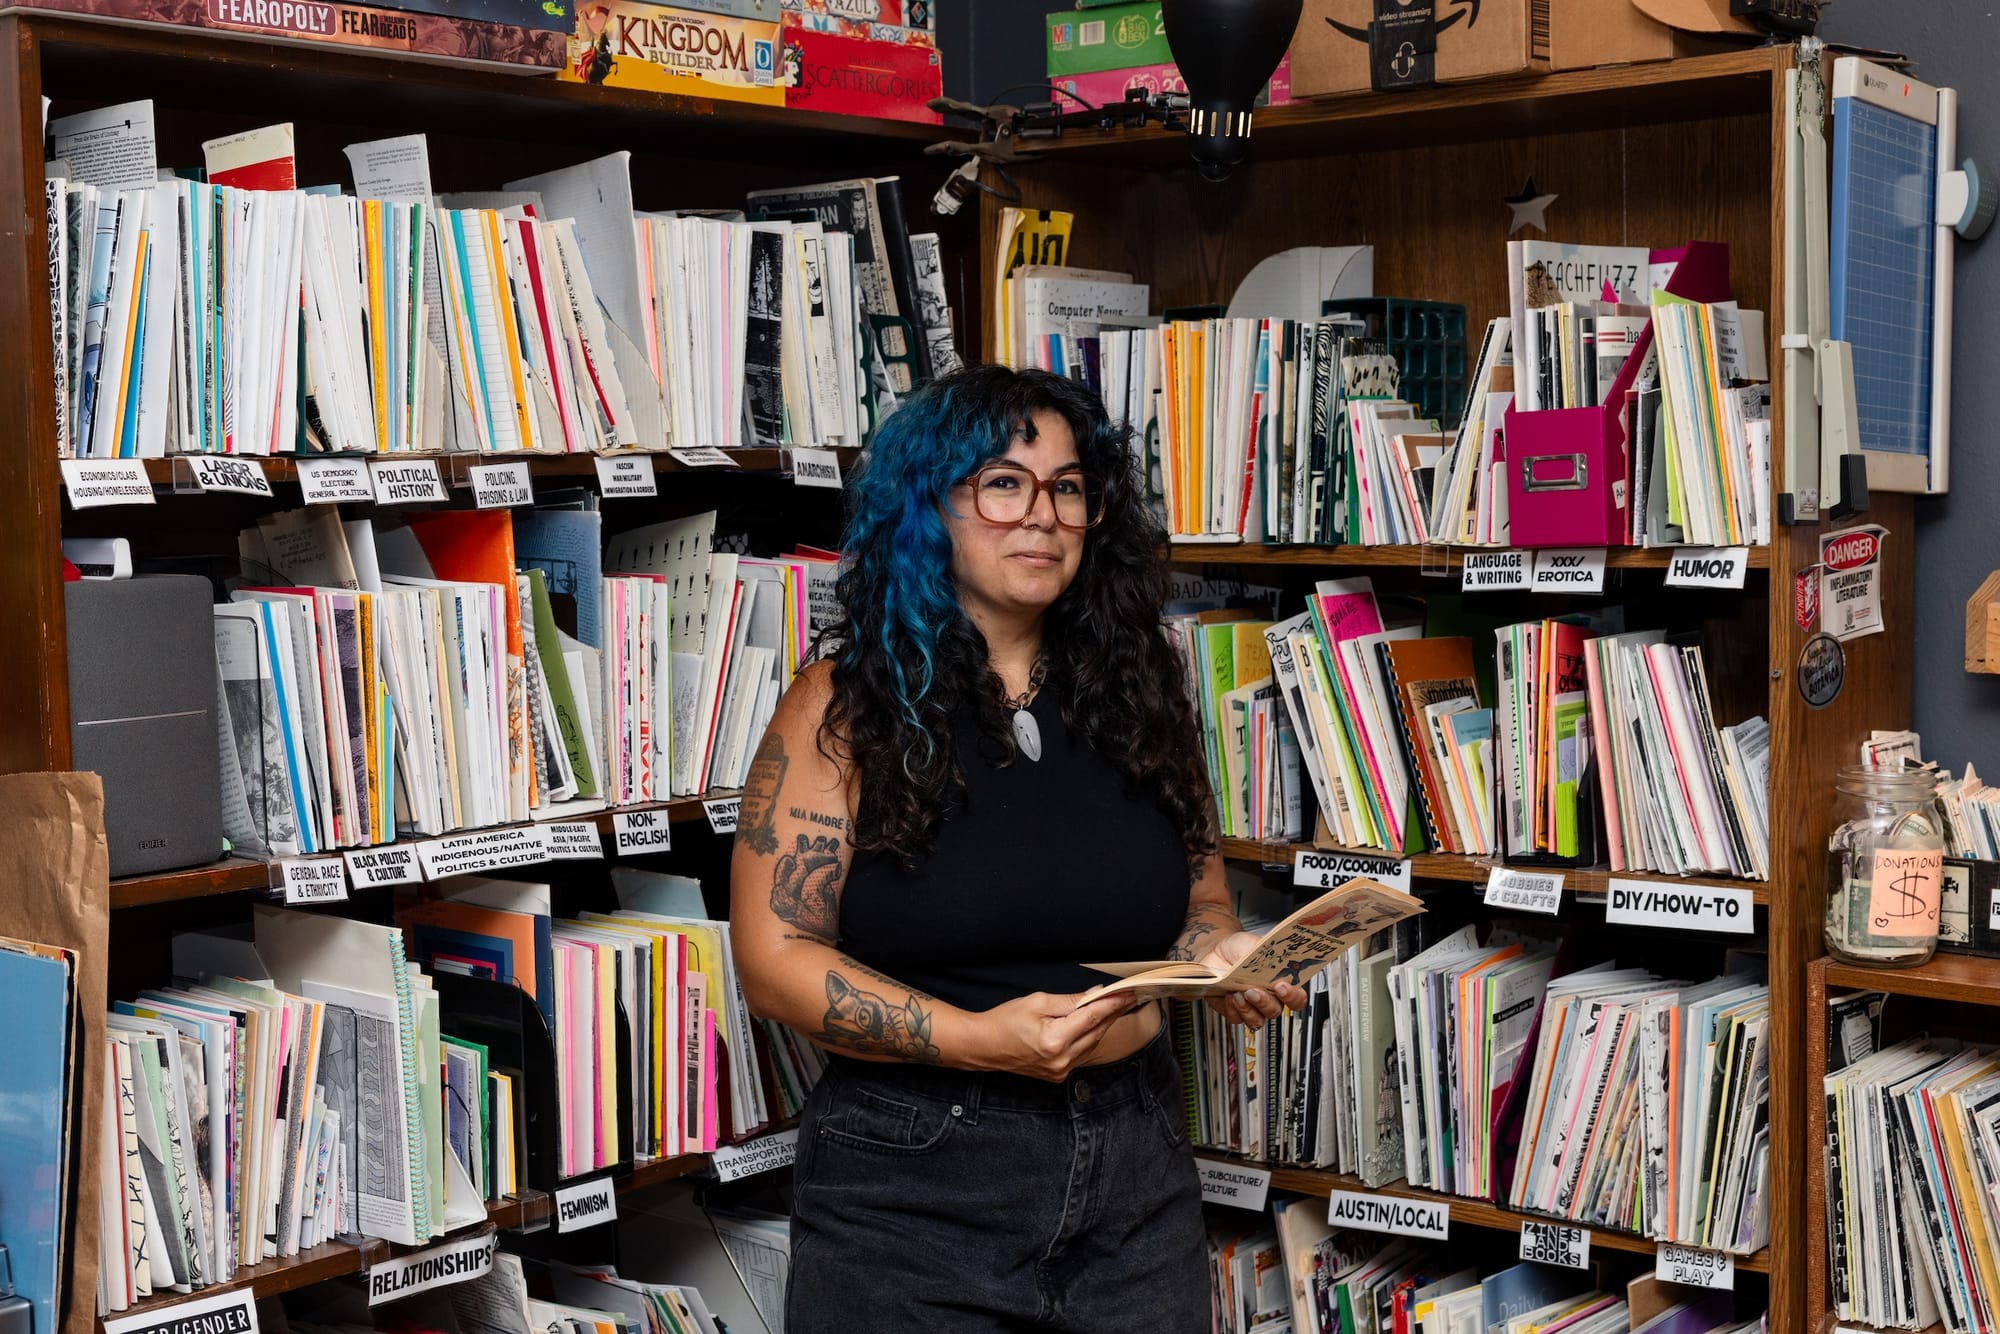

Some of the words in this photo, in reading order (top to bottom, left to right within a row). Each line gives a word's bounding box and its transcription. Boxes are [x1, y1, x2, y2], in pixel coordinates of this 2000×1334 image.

[218, 0, 329, 32] FEAROPOLY
[1379, 12, 1398, 22] video
[1399, 8, 1431, 20] streaming
[341, 10, 379, 37] FEAR
[408, 19, 417, 41] 6
[380, 24, 406, 40] DEAD
[1052, 23, 1073, 44] MB
[1128, 22, 1145, 33] BIG
[616, 13, 749, 72] KINGDOM
[1126, 31, 1146, 42] BEN
[649, 51, 717, 71] BUILDER
[807, 63, 936, 99] SCATTERGORIES
[1048, 302, 1093, 320] Computer
[202, 459, 250, 477] LABOR
[616, 462, 634, 470] FASCISM
[796, 462, 837, 480] ANARCHISM
[80, 471, 138, 482] ECONOMICS/CLASS
[200, 472, 214, 486] &
[214, 472, 268, 492] UNIONS
[321, 479, 355, 488] ELECTIONS
[377, 468, 437, 484] POLITICAL
[73, 485, 152, 498] HOUSING/HOMELESSNESS
[308, 490, 338, 498] GENERAL
[339, 489, 371, 497] POLITICAL
[388, 484, 435, 499] HISTORY
[479, 490, 507, 505] PRISONS
[508, 490, 514, 501] &
[514, 488, 529, 502] LAW
[604, 486, 632, 495] IMMIGRATION
[637, 485, 655, 494] BORDERS
[1828, 537, 1873, 566] DANGER
[1466, 554, 1522, 569] LANGUAGE
[1550, 556, 1585, 568] XXX/
[1673, 559, 1735, 580] HUMOR
[1465, 572, 1473, 585] &
[1477, 570, 1522, 584] WRITING
[1537, 570, 1594, 583] EROTICA
[1170, 581, 1202, 599] BAD
[1835, 584, 1868, 604] LITERATURE
[626, 812, 657, 829] NON-
[789, 807, 807, 820] MIA
[809, 811, 843, 830] MADRE
[138, 839, 168, 850] EDIFIER
[441, 836, 471, 850] LATIN
[476, 831, 525, 845] AMERICA
[553, 834, 591, 844] ASIA/PACIFIC
[619, 828, 669, 848] ENGLISH
[431, 840, 543, 864] INDIGENOUS/NATIVE
[546, 845, 573, 855] POLITICS
[579, 844, 602, 853] CULTURE
[353, 853, 378, 869] BLACK
[379, 850, 411, 867] POLITICS
[437, 859, 487, 875] POLITICS
[489, 858, 497, 866] &
[499, 852, 546, 865] CULTURE
[1301, 856, 1402, 876] FOOD/COOKING
[1875, 855, 1941, 870] DONATIONS
[290, 866, 320, 881] GENERAL
[321, 864, 341, 879] RACE
[367, 870, 375, 882] &
[375, 866, 407, 881] CULTURE
[1321, 874, 1331, 887] &
[297, 887, 304, 898] &
[306, 883, 338, 898] ETHNICITY
[1499, 873, 1554, 892] HOBBIES
[1501, 890, 1557, 908] CRAFTS
[1885, 869, 1930, 920] $
[1612, 890, 1739, 918] DIY/HOW-TO
[1361, 1012, 1370, 1043] REVIEW
[731, 1168, 739, 1178] &
[1208, 1169, 1263, 1187] SUBCULTURE/
[1202, 1183, 1238, 1197] CULTURE
[560, 1193, 610, 1221] FEMINISM
[1335, 1198, 1444, 1232] AUSTIN/LOCAL
[1524, 1222, 1580, 1242] ZINES
[1536, 1235, 1569, 1252] AND
[1524, 1248, 1580, 1266] BOOKS
[1664, 1247, 1714, 1268] GAMES
[1717, 1252, 1726, 1271] &
[371, 1243, 492, 1297] RELATIONSHIPS
[1673, 1267, 1714, 1286] PLAY
[1498, 1294, 1537, 1324] Daily
